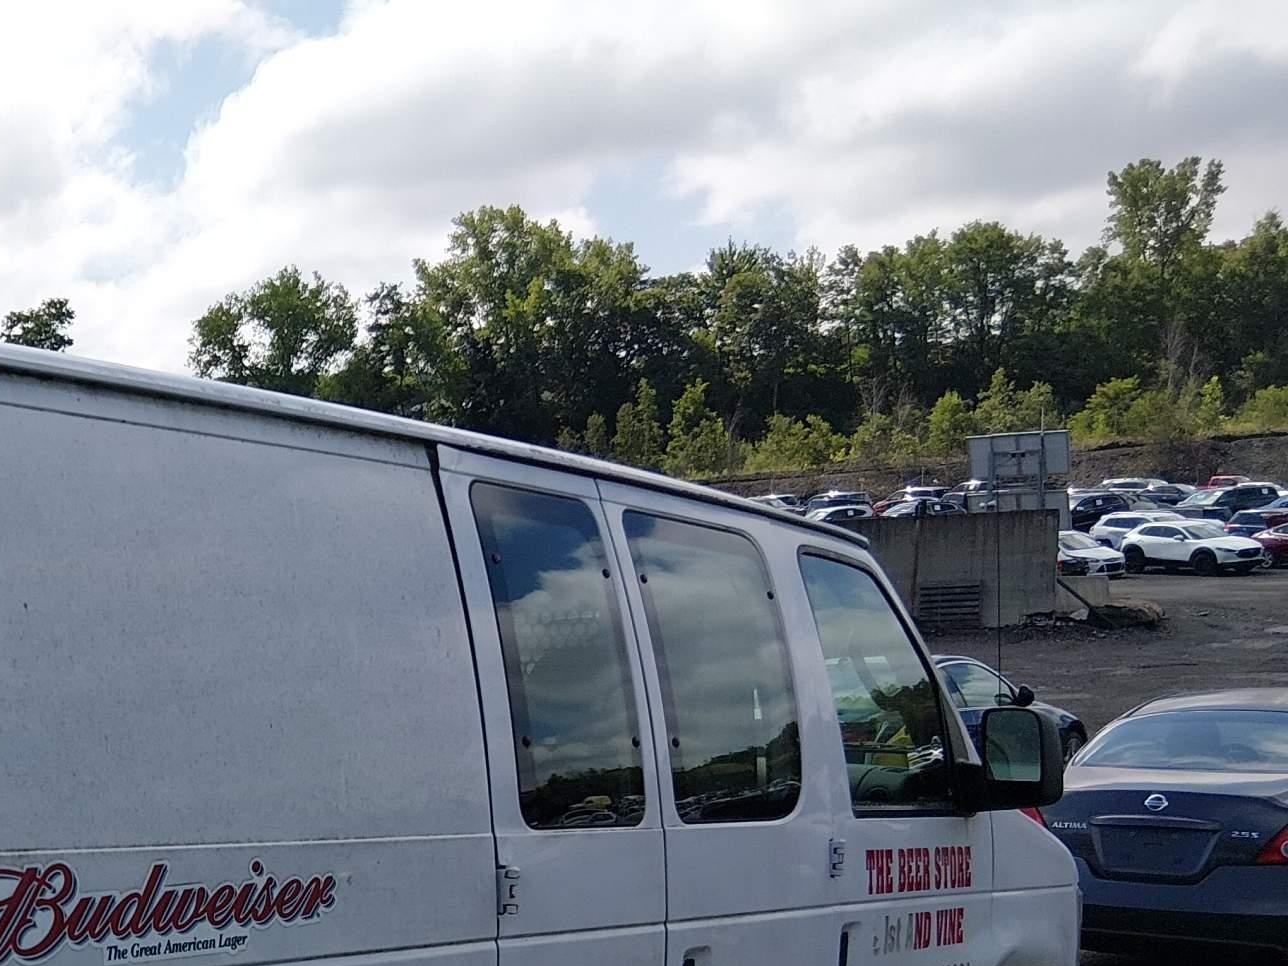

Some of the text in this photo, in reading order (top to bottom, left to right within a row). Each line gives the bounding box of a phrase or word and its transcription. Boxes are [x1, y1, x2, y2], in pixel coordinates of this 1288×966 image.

[1052, 821, 1087, 830] ALTIMA
[866, 846, 972, 895] THE BEER STORE
[107, 933, 248, 961] The Great American Lager
[905, 911, 932, 951] AND
[936, 907, 964, 948] VINE
